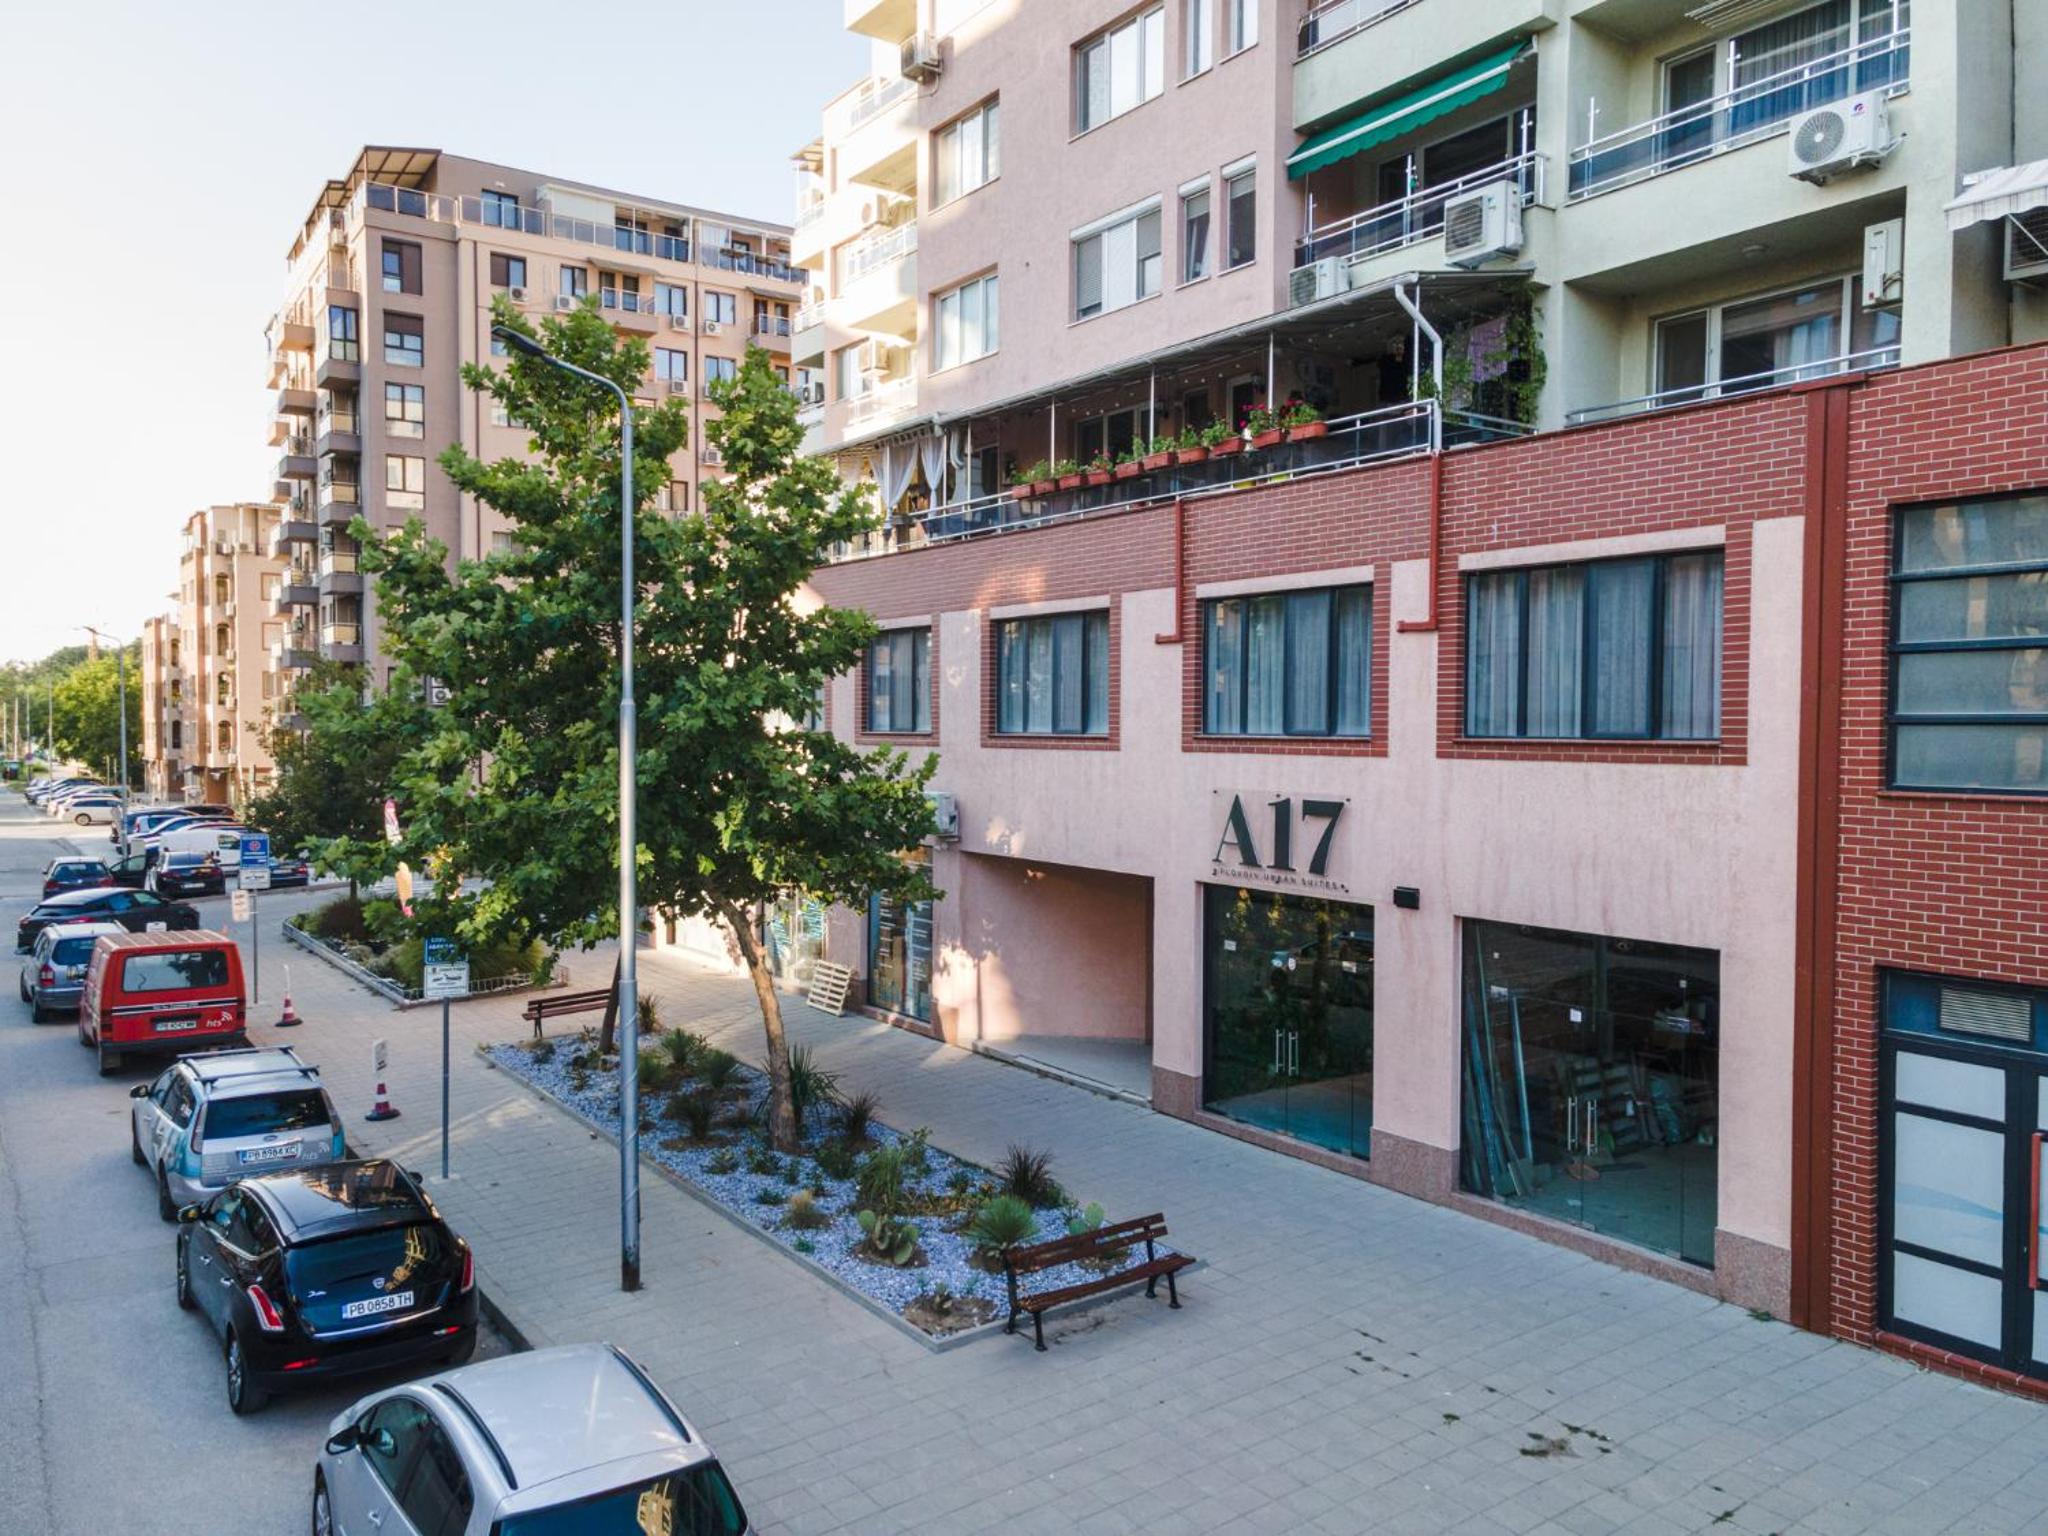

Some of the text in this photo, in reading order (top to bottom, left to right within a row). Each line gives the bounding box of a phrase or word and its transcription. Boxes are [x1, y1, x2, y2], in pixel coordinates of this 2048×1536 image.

[1212, 794, 1345, 877] A17
[349, 1294, 412, 1316] PB 0858 TH
